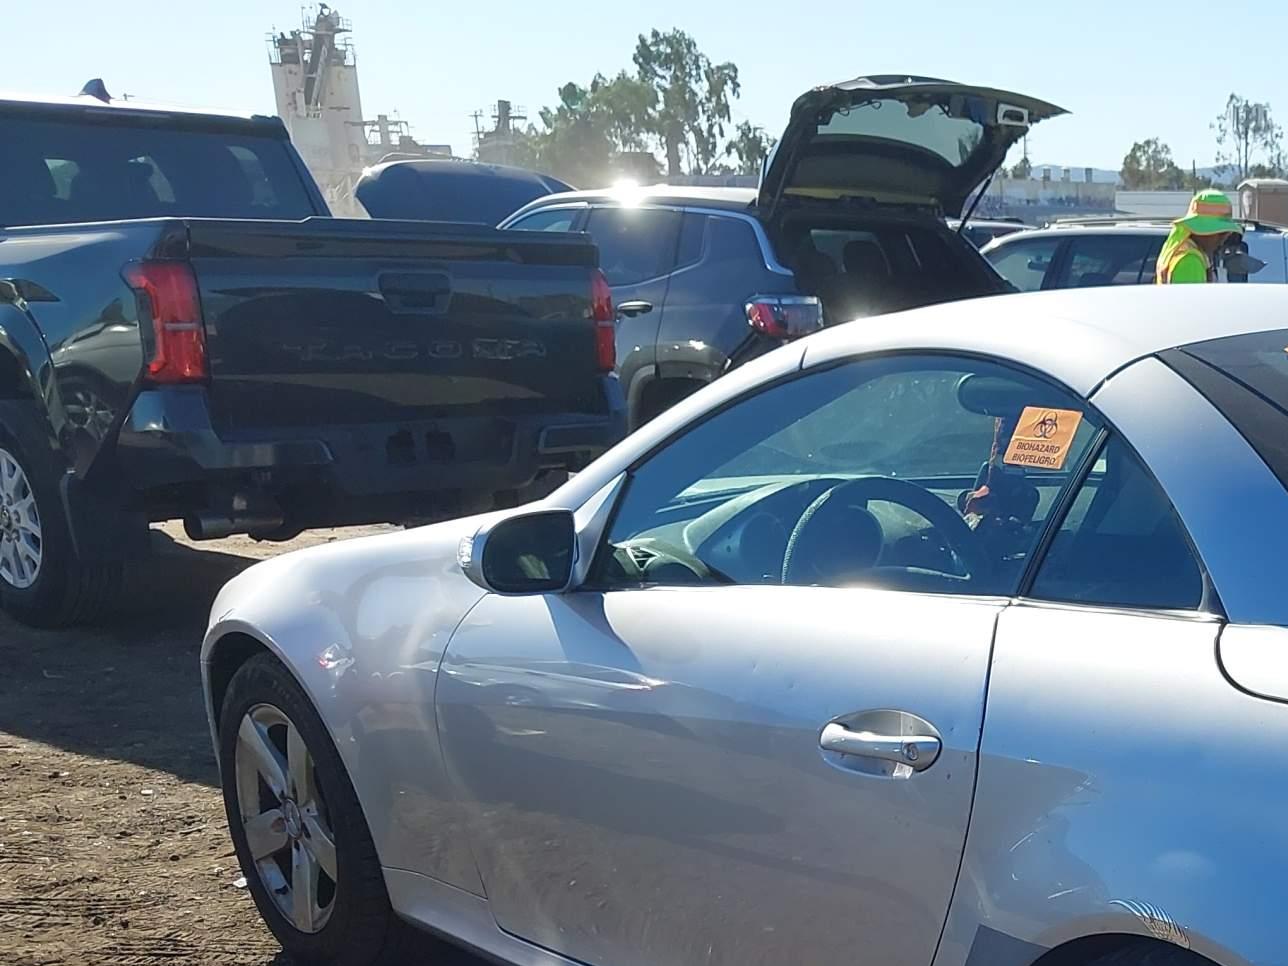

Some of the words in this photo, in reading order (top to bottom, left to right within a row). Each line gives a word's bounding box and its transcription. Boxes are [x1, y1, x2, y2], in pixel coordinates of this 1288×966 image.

[281, 337, 547, 361] TACOMA
[1016, 441, 1060, 454] BIOHAZARD
[1011, 453, 1056, 465] BIOPELIGRO
